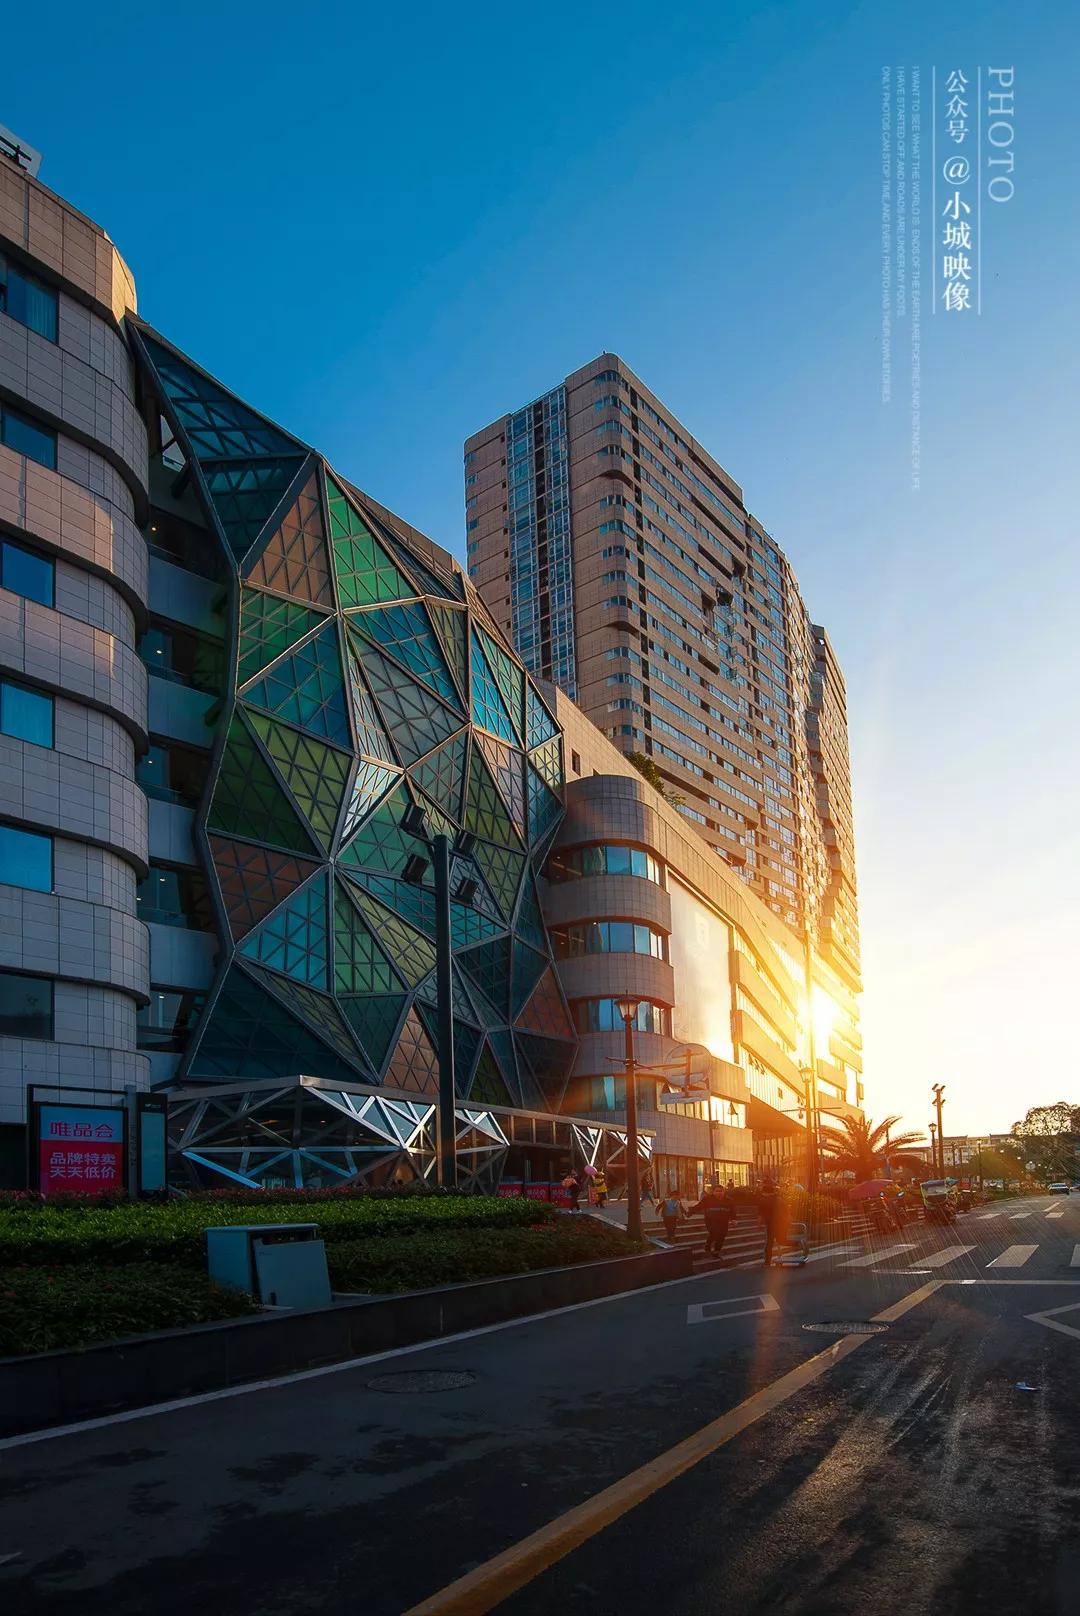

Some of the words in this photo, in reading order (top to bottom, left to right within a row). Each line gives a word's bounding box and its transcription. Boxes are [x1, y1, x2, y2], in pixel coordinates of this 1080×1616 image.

[50, 1121, 113, 1138] 唯品会
[50, 1152, 116, 1165] 品牌特卖
